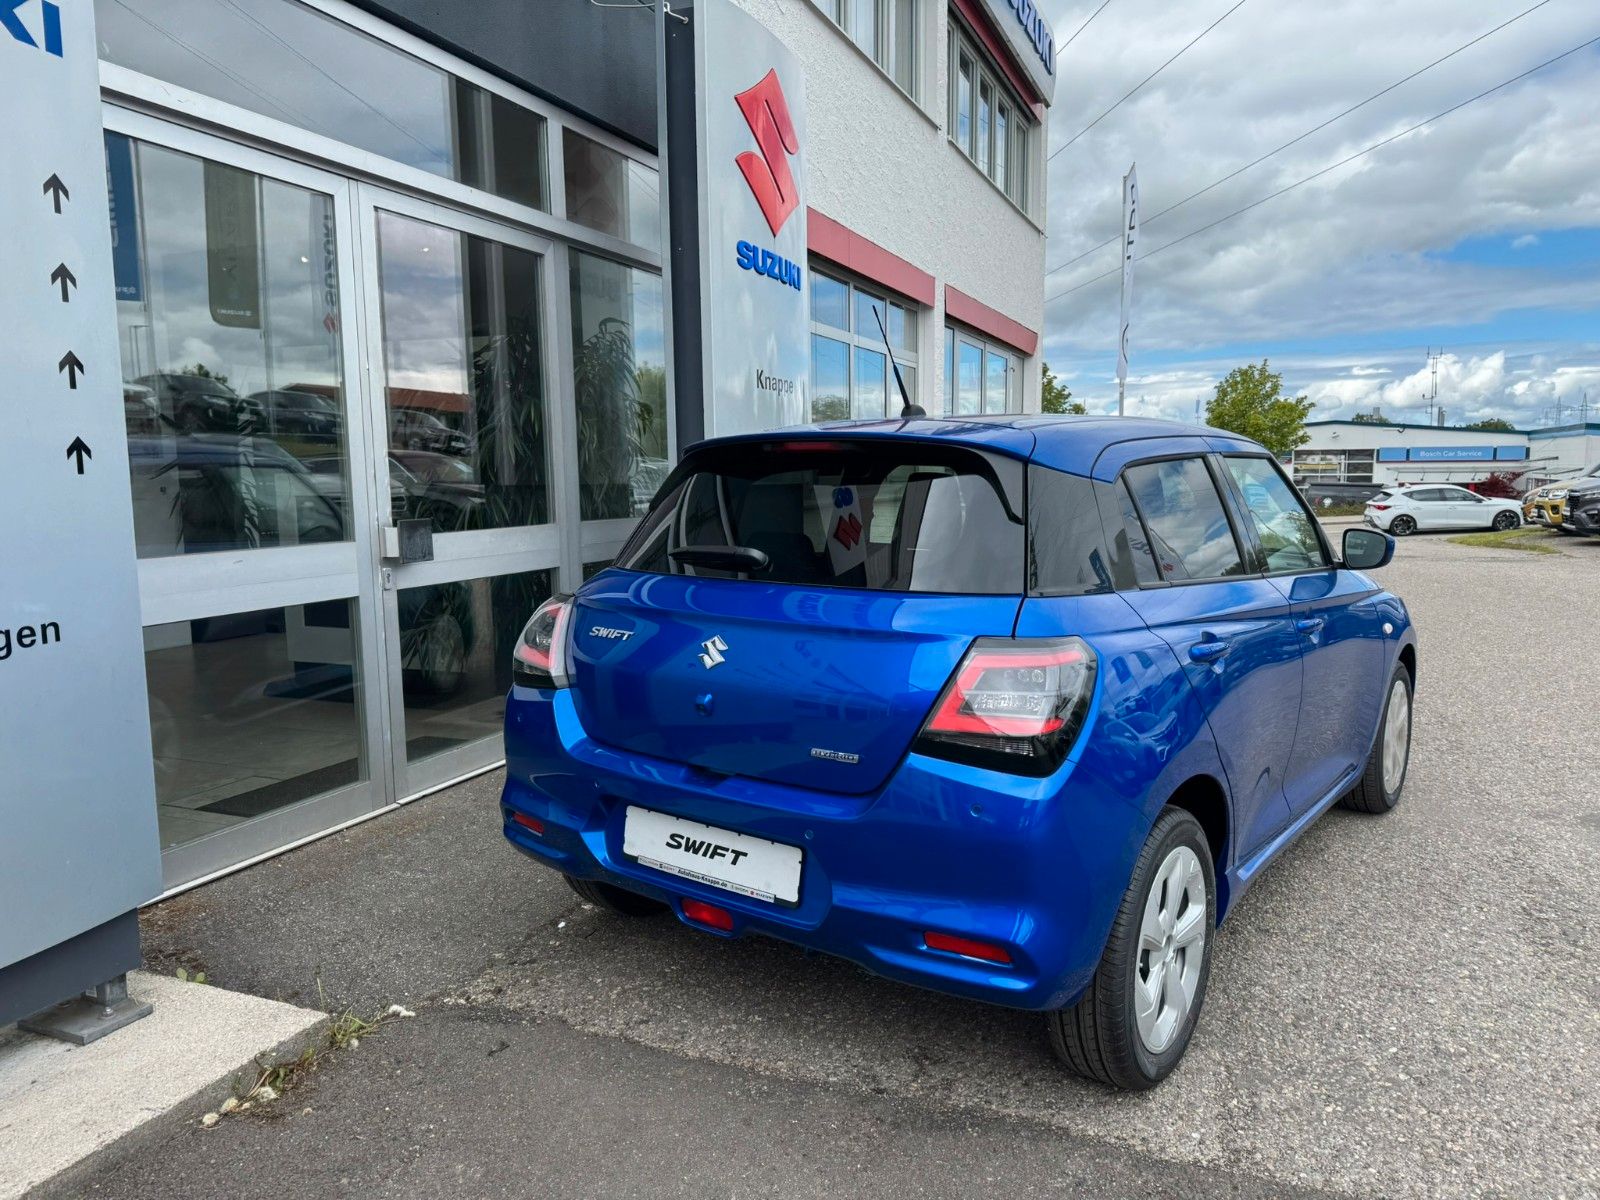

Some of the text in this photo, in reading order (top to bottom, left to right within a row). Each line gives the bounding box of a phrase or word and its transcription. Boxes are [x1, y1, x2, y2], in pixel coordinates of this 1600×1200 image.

[736, 240, 801, 291] SUZUKI
[756, 369, 794, 396] Knappe
[1457, 449, 1482, 457] Service
[589, 626, 635, 640] SWIFT
[665, 832, 749, 866] SWIFT
